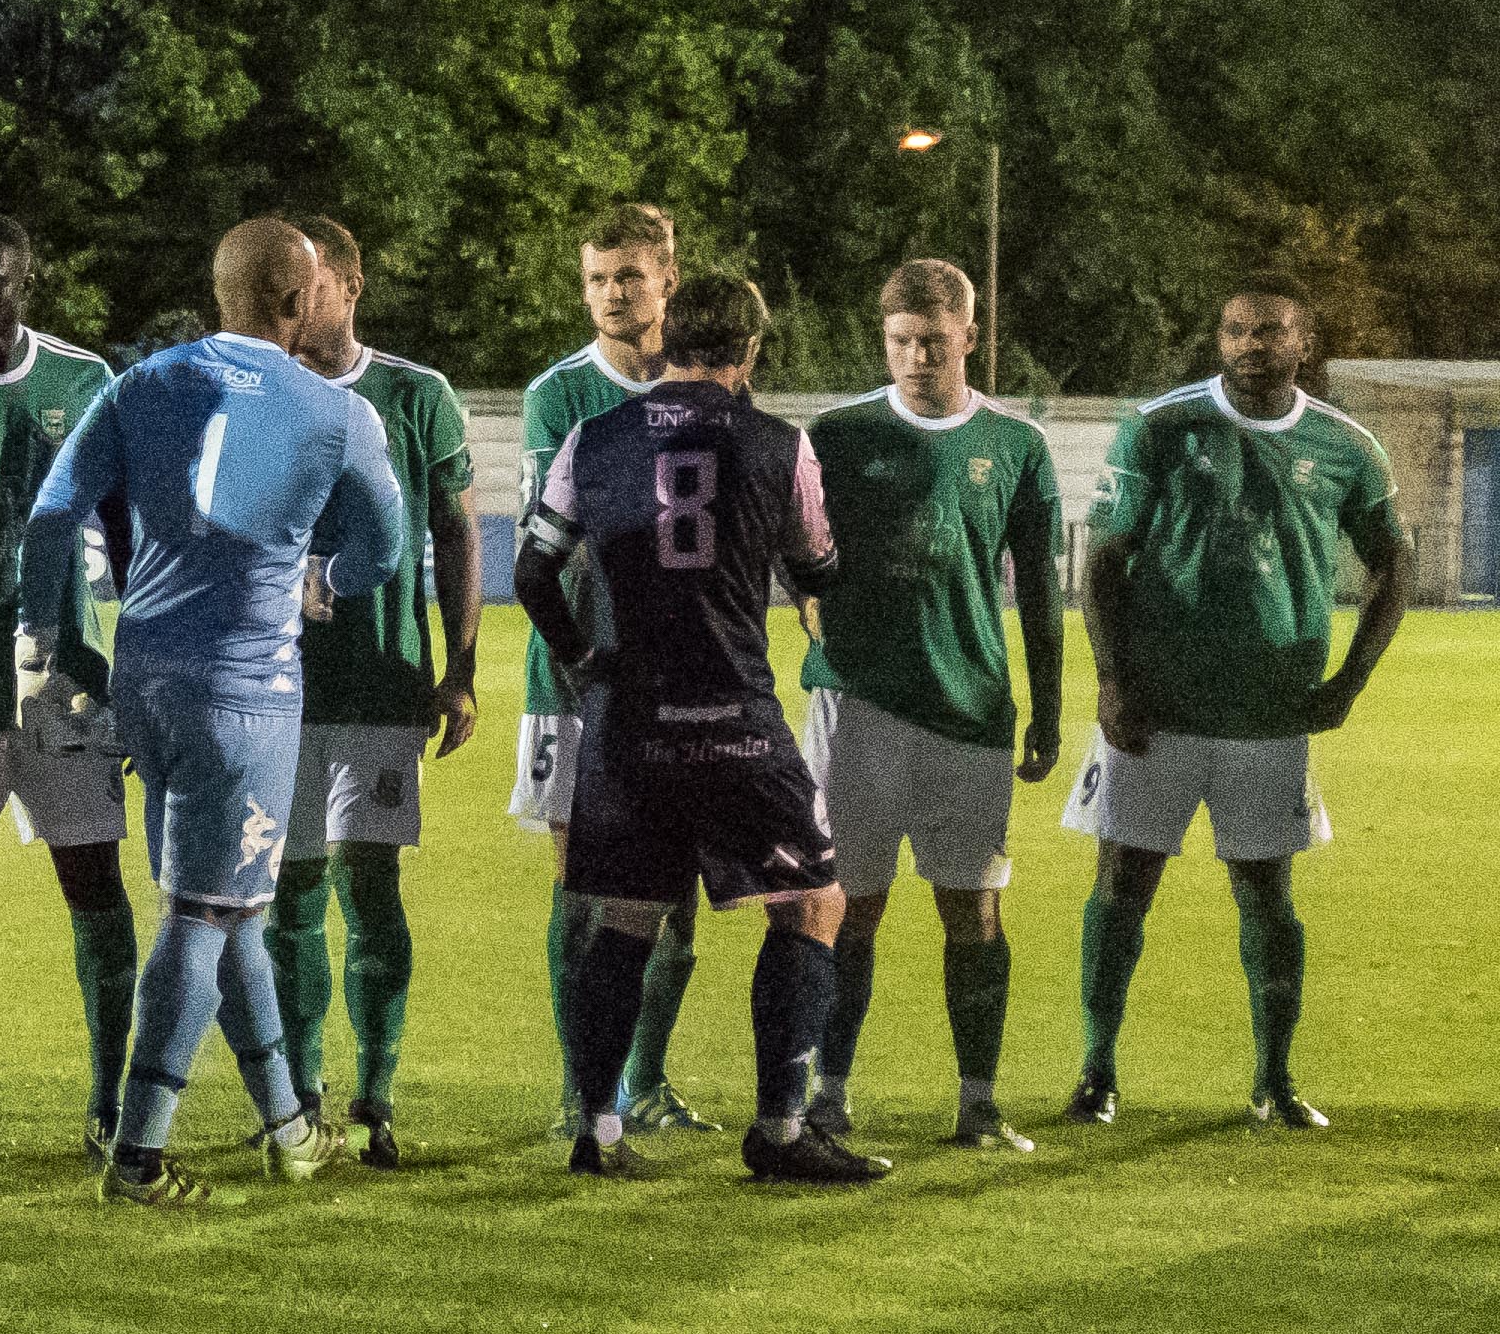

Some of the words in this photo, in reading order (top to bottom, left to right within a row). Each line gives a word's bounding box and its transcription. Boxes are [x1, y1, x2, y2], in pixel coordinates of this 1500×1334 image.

[655, 451, 717, 569] 8
[531, 735, 557, 783] 5
[1081, 762, 1102, 807] 9
